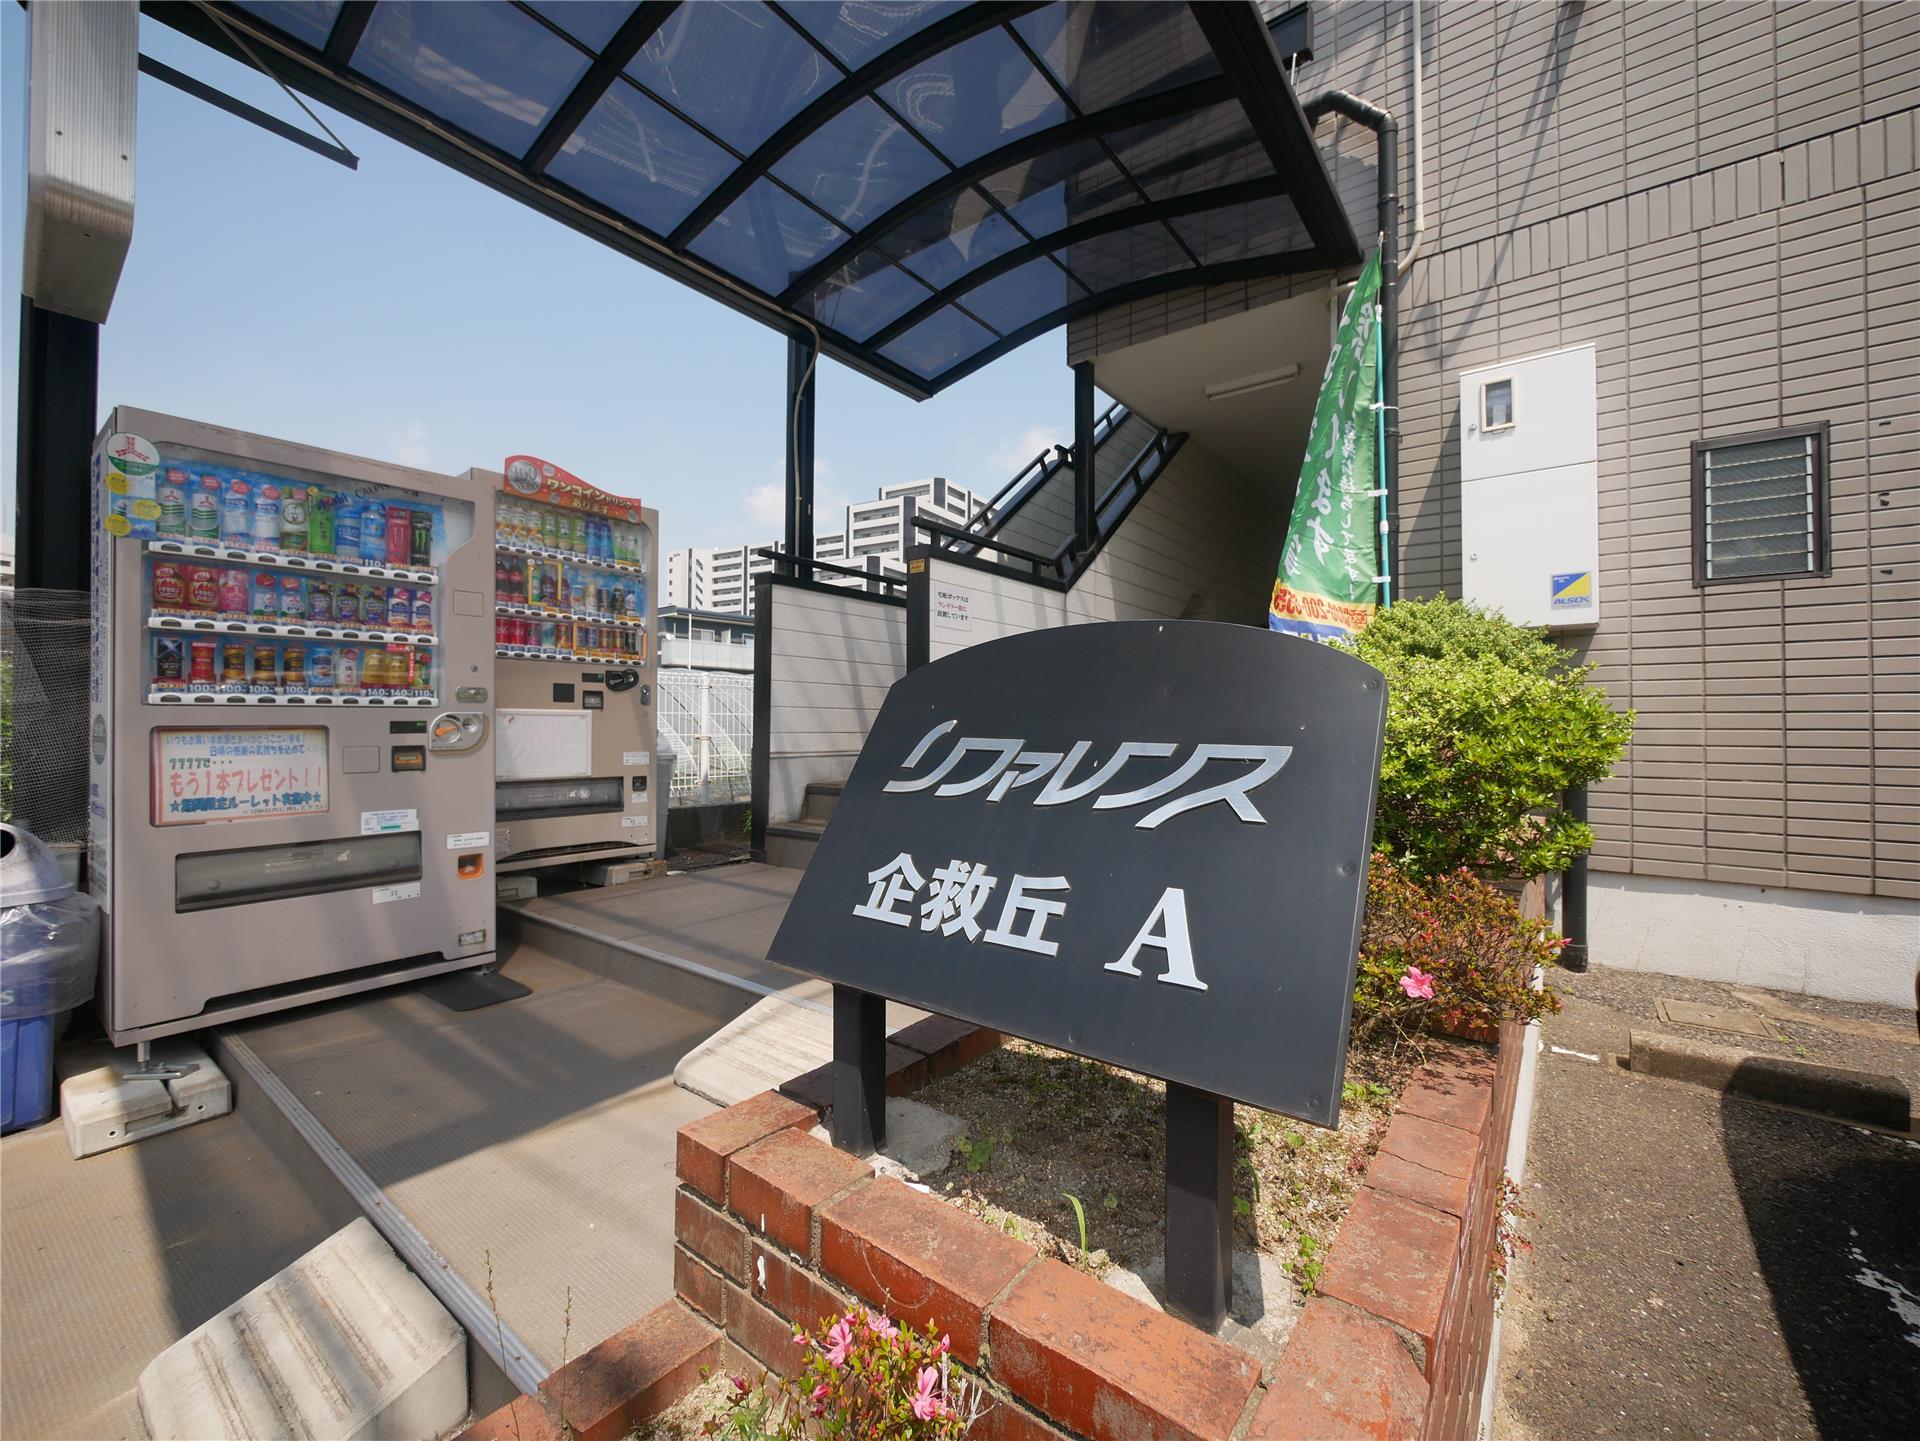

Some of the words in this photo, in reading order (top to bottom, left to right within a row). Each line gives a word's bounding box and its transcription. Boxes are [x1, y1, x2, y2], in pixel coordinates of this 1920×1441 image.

[547, 478, 632, 509] ワンコインドリンク
[1552, 596, 1590, 605] ALSOK
[883, 719, 1293, 831] リファレンス
[852, 853, 1071, 957] 企救丘
[1104, 887, 1209, 991] A
